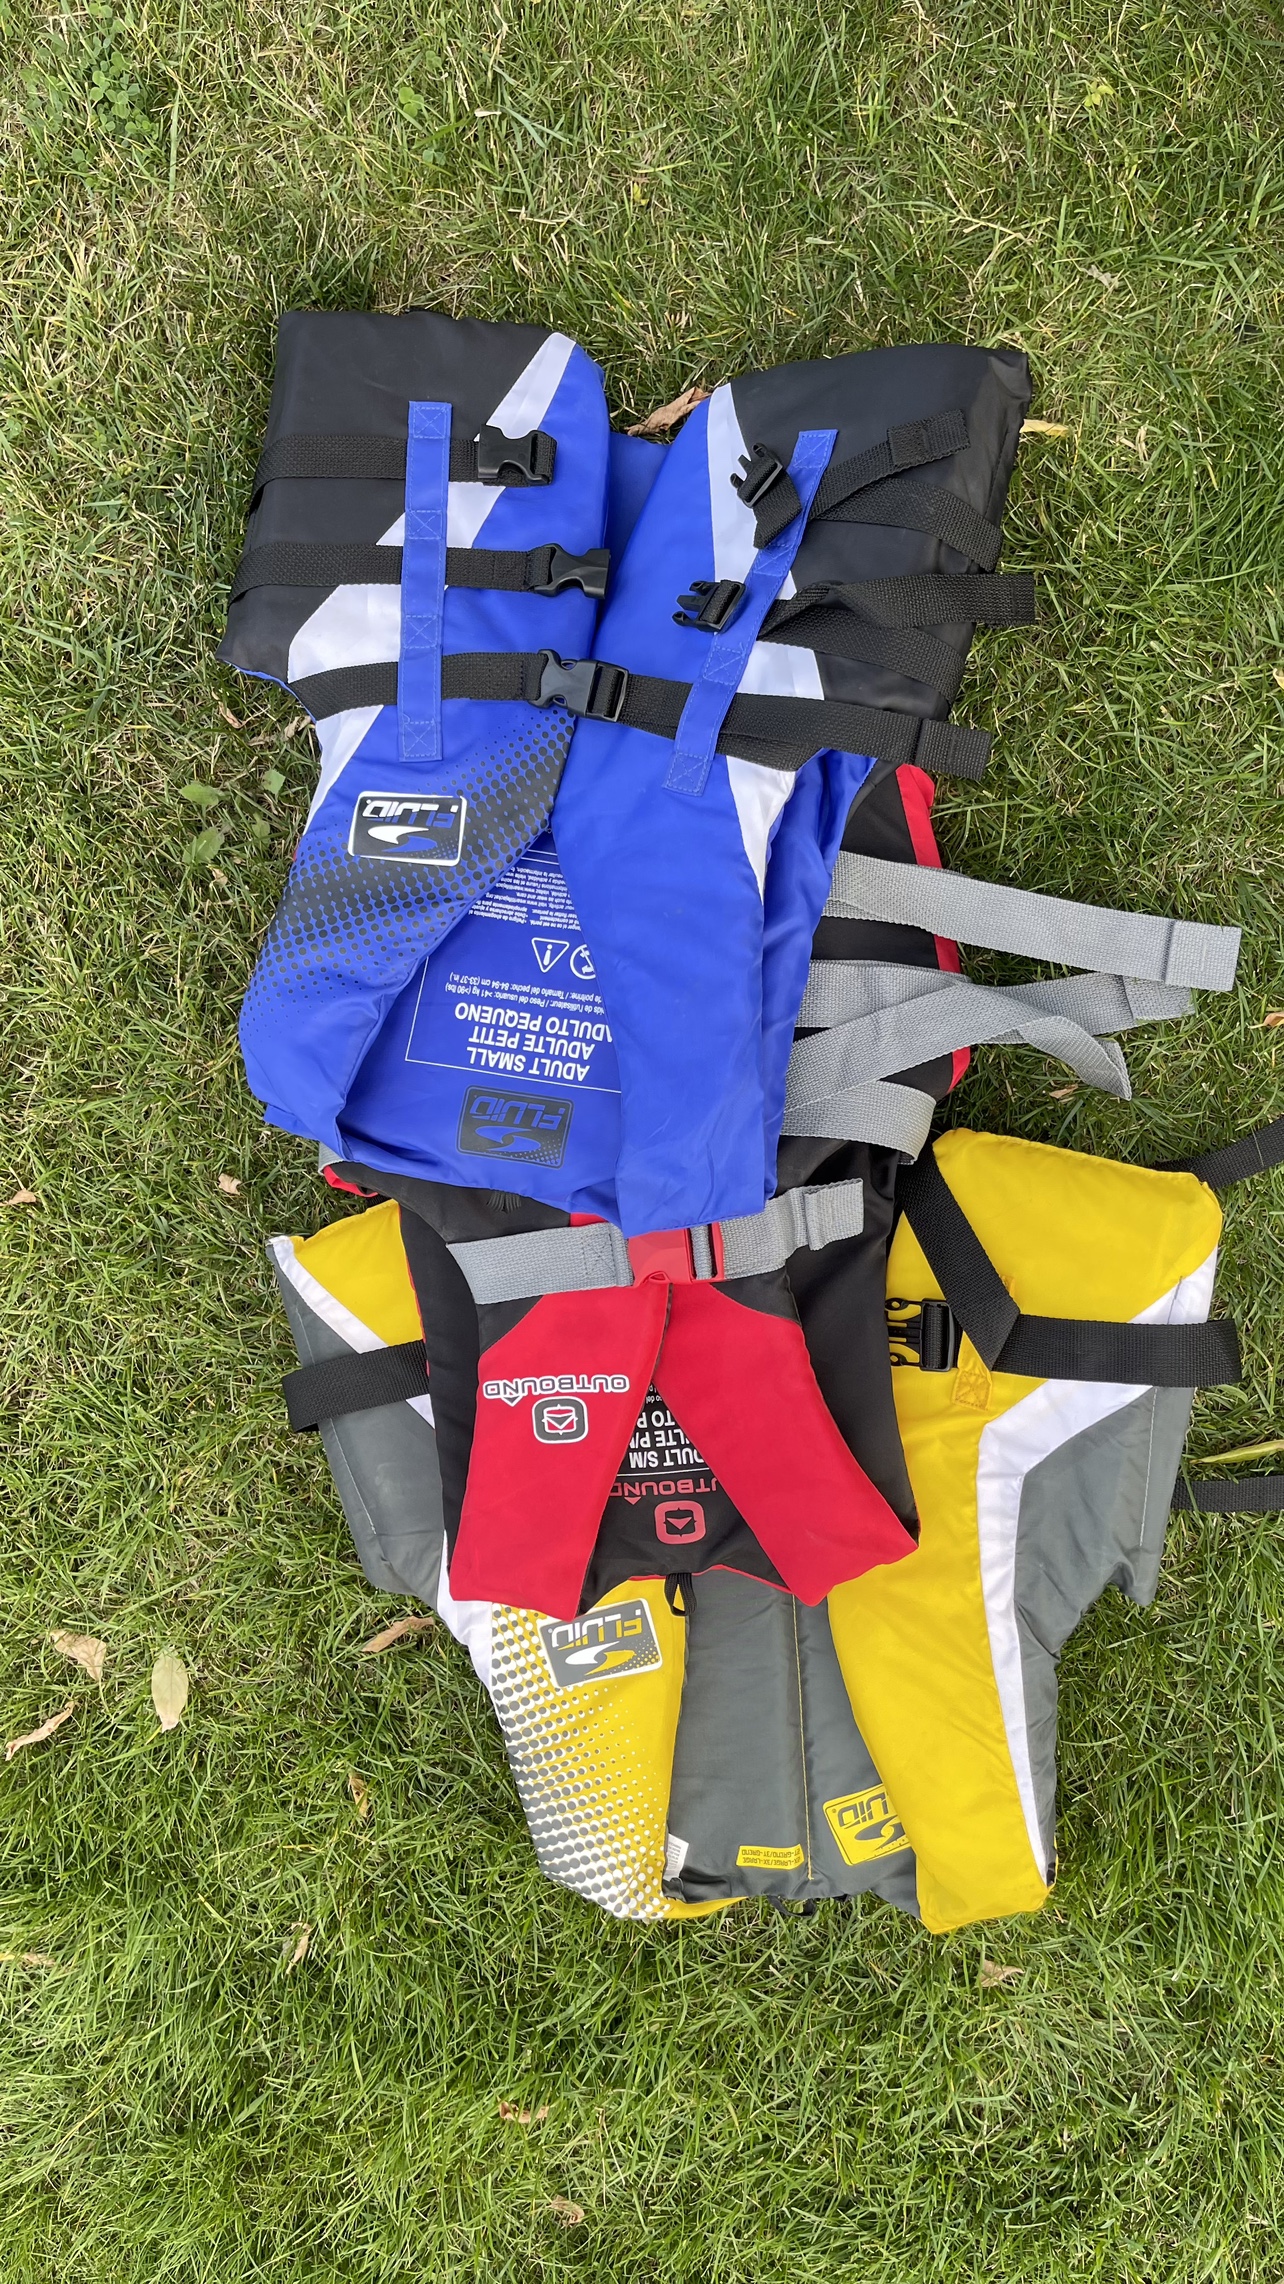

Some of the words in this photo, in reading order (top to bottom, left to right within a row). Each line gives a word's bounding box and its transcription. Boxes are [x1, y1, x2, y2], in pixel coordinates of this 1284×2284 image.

[362, 800, 459, 828] FLUID
[471, 986, 480, 996] kg
[518, 996, 529, 1004] del
[529, 997, 546, 1007] Peso
[530, 987, 540, 995] del
[541, 988, 564, 999] Tamaño
[455, 1002, 542, 1031] PEQUENO
[468, 1026, 520, 1049] PETIT
[523, 1034, 595, 1060] ADULTE
[467, 1047, 526, 1072] SMALL
[528, 1057, 590, 1081] ADULT
[470, 1096, 565, 1130] FLUID
[483, 1375, 629, 1400] OUTBOUND
[629, 1451, 659, 1468] S/M
[663, 1448, 704, 1467] DULT
[552, 1609, 642, 1651] FLUID
[838, 1792, 889, 1827] UID
